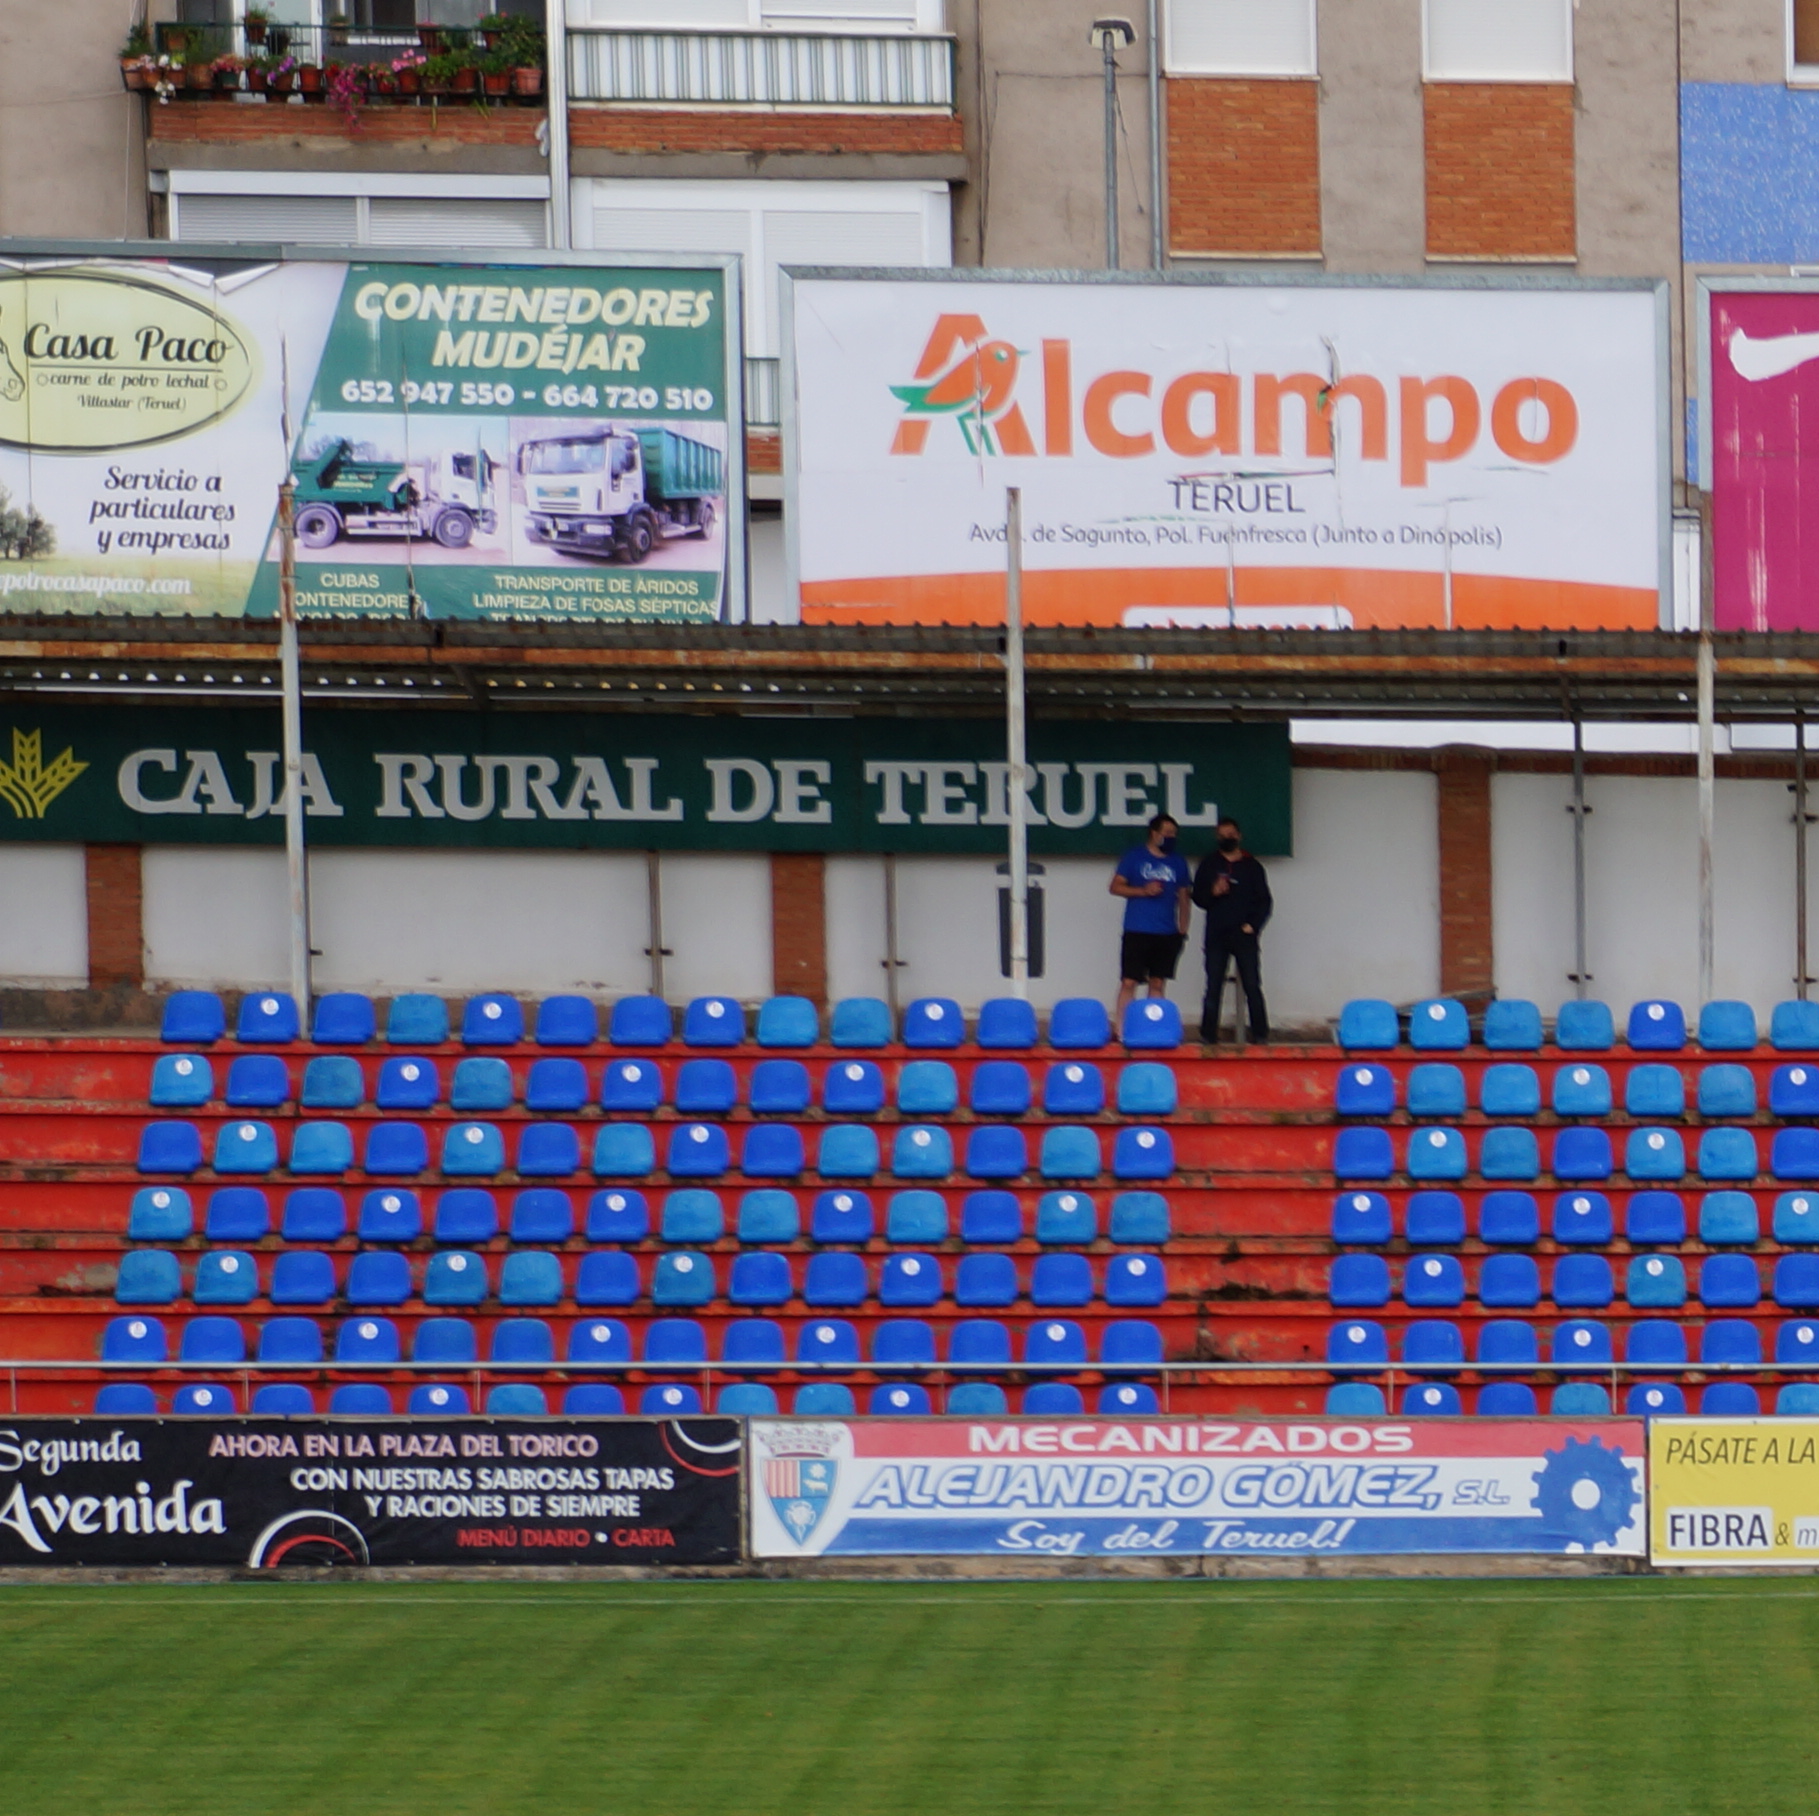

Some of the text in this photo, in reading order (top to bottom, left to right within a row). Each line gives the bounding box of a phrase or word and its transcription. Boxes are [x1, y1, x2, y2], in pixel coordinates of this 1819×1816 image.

[355, 281, 714, 329] CONTENEDORES
[24, 323, 234, 363] Casa Paco
[432, 324, 646, 375] MUDÉJAR
[50, 374, 209, 391] carne potro lechal
[341, 379, 713, 411] 652 947 550 664 720 510
[888, 313, 1580, 487] Alcampo
[104, 466, 222, 492] Servicio a
[89, 497, 235, 524] particulares
[1167, 480, 1306, 514] TERUEL
[97, 530, 230, 555] y empresas
[1032, 522, 1503, 550] de Sagunto, Pol. Fuenfresca (Junto a Dinópolis)
[320, 572, 380, 588] CUBAS
[495, 574, 631, 594] TRANSPORTE DE
[473, 593, 636, 614] LIMPIEZA DE FOSAS
[118, 748, 1218, 828] CAJA RURAL DE TERUEL
[210, 1434, 599, 1458] AHORA EN LA PLAZA DEL TORICO
[969, 1425, 1413, 1453] MECANIZADOS
[1666, 1432, 1758, 1465] PÁSATE
[1762, 1438, 1780, 1463] A
[1787, 1438, 1816, 1464] LA
[0, 1431, 142, 1479] Segunda
[291, 1467, 675, 1492] CON NUESTRAS SABROSAS TAPAS
[858, 1462, 1441, 1511] ALEJANDRO GÓMEZ,
[0, 1481, 227, 1553] Avenida
[364, 1494, 640, 1518] Y RACIONES DE SIEMPRE
[457, 1523, 676, 1549] MENÚ DIARIO CARTA
[997, 1518, 1350, 1555] Soy del Teruel!
[1670, 1513, 1768, 1547] FIBRA
